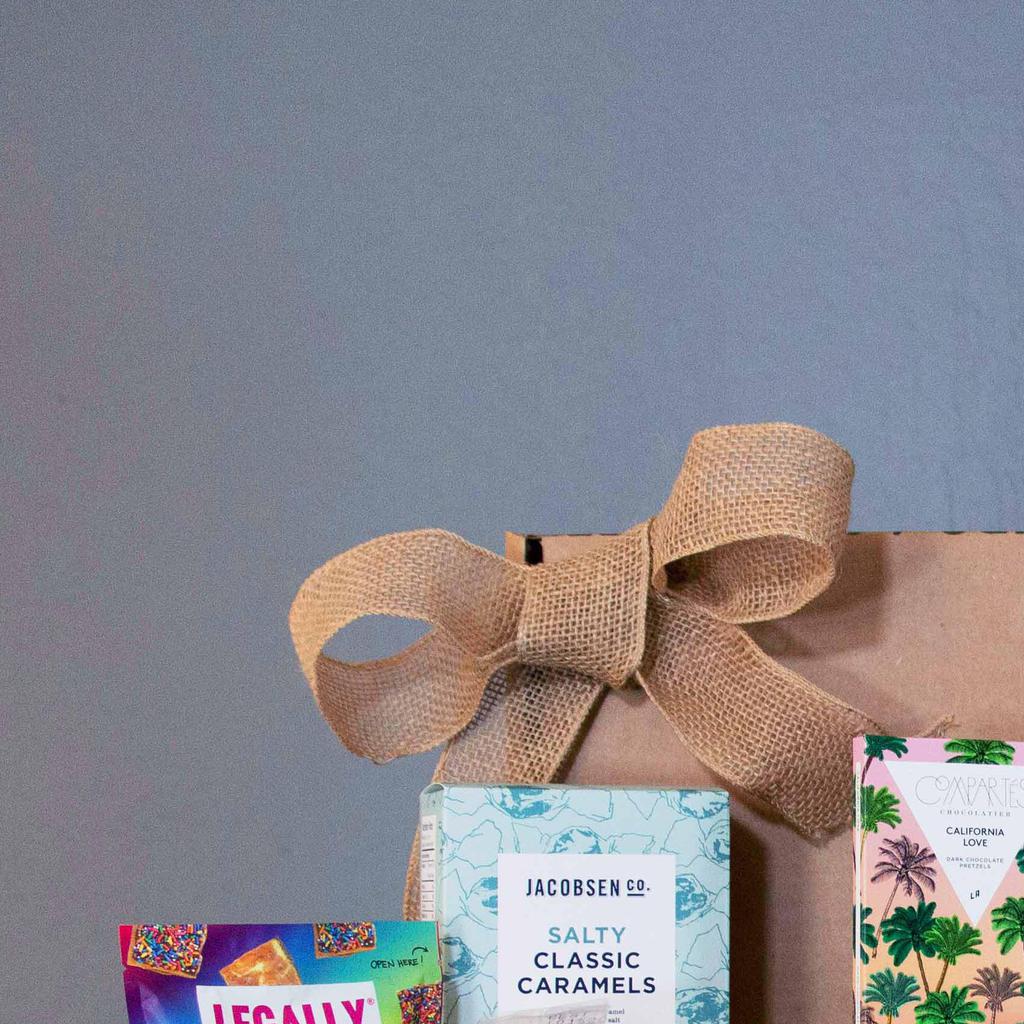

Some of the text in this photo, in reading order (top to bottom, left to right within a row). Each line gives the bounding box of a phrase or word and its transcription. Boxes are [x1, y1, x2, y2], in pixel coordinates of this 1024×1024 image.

[940, 809, 1012, 817] CHOCOLATIER
[946, 827, 1005, 837] CALIFORNIA
[963, 839, 988, 847] LOVE
[526, 878, 650, 897] JACOBSEN CO.
[548, 927, 626, 944] SALTY
[370, 959, 395, 969] OPEN
[533, 952, 640, 969] CLASSIC
[517, 976, 656, 994] CARAMELS
